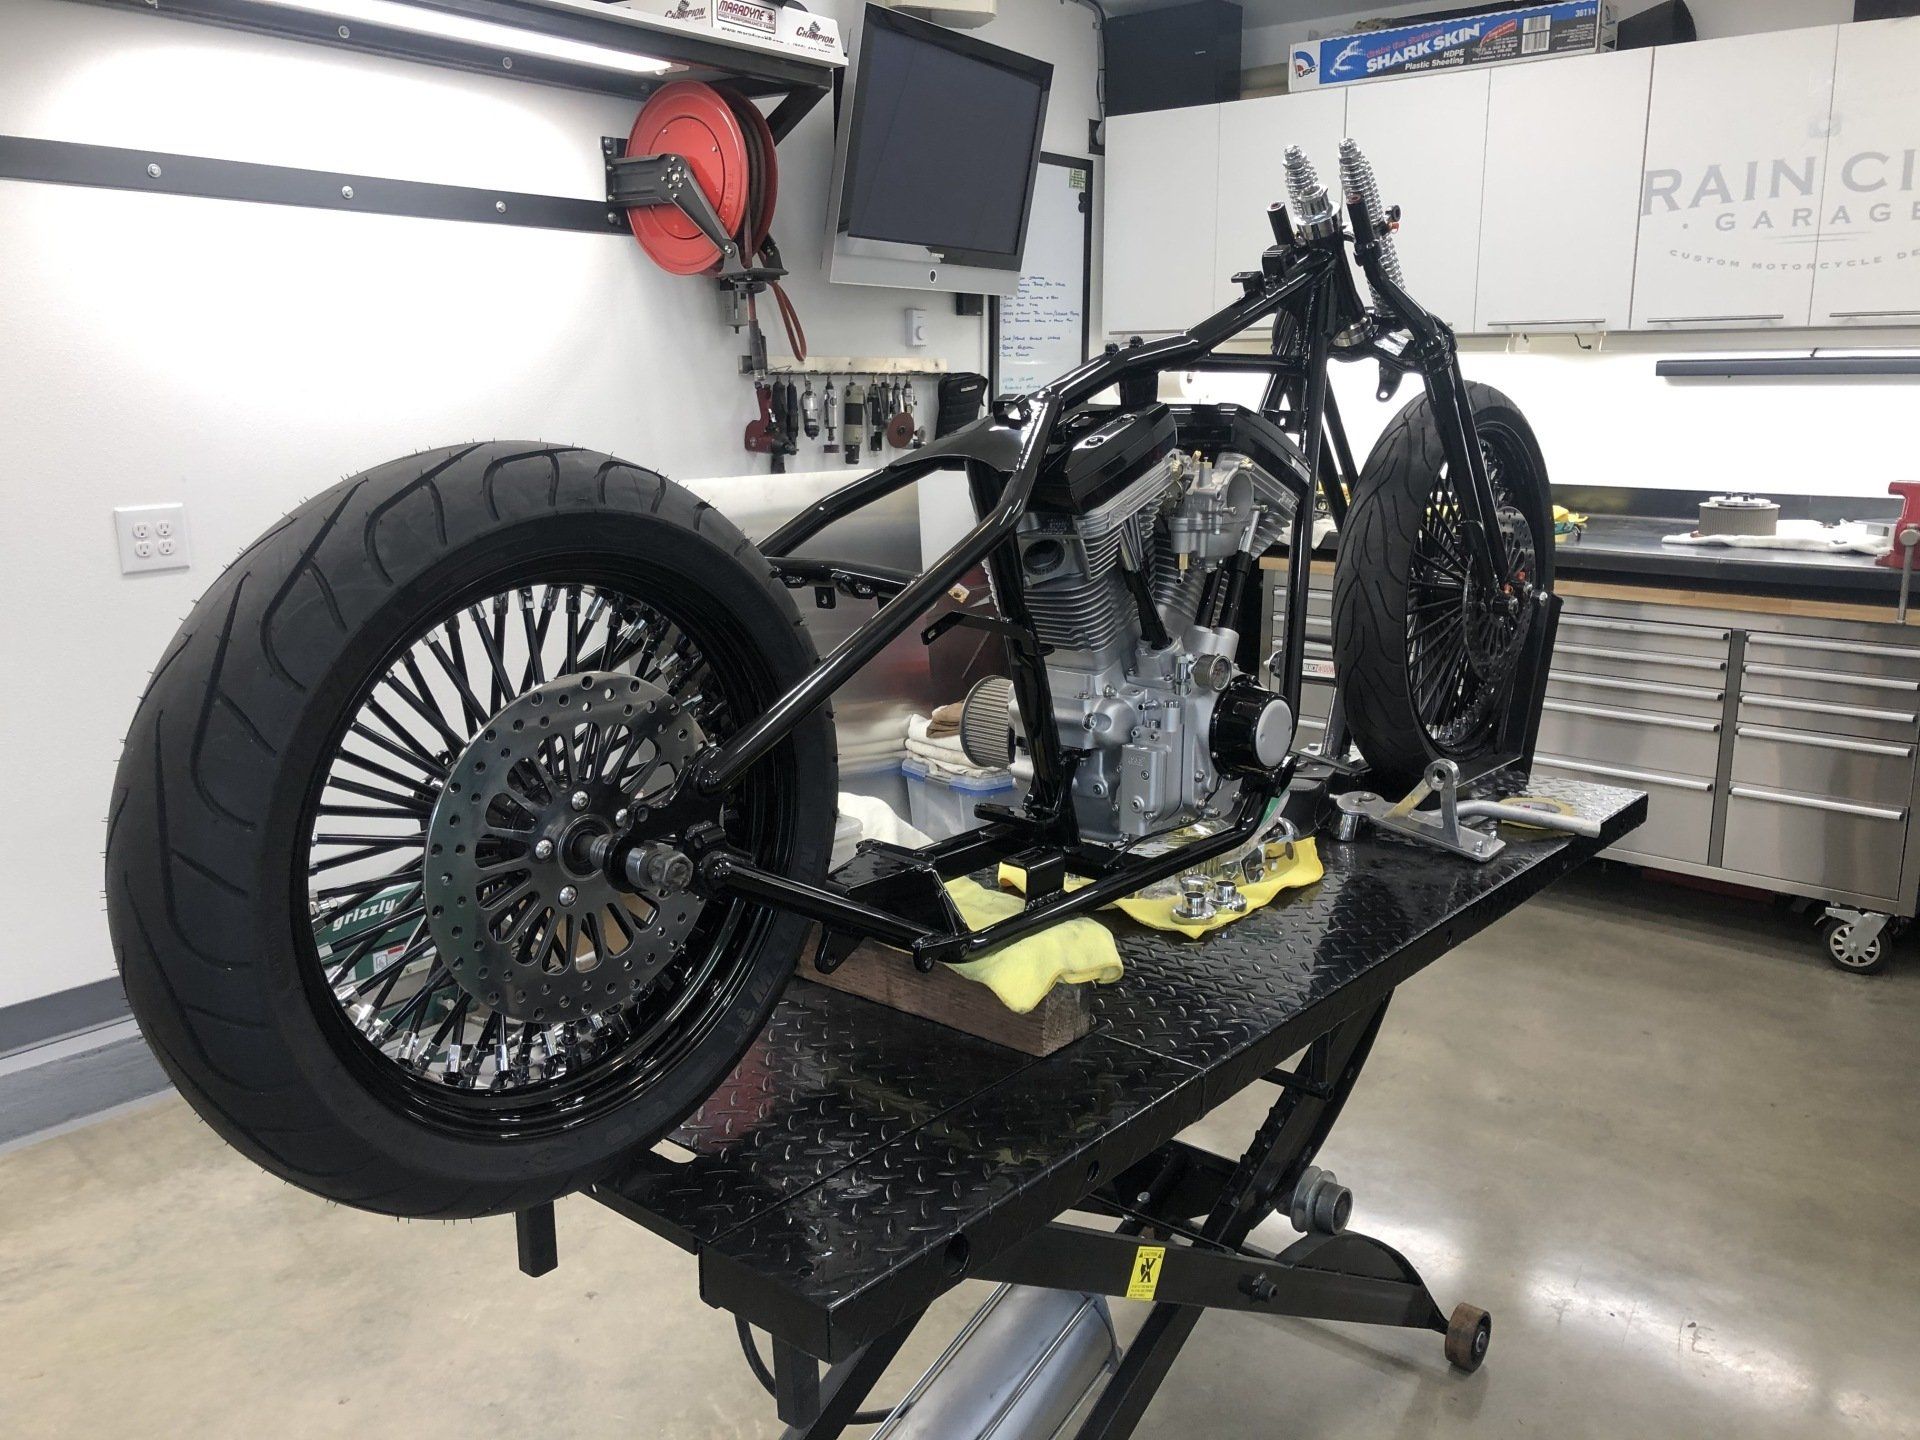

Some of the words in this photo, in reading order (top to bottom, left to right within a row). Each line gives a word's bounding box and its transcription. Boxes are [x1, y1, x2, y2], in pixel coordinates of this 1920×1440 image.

[664, 7, 706, 20] CHAMPION
[719, 0, 765, 20] MARADYNE
[796, 26, 836, 44] CHAMPION
[1366, 40, 1432, 73] SHARK
[1443, 48, 1465, 58] HDPE
[1297, 66, 1317, 78] USC
[1404, 61, 1430, 71] Plastic
[1431, 56, 1465, 68] Sheeting
[1640, 156, 1816, 216] RAIN
[1841, 149, 1916, 193] CI
[1715, 201, 1920, 231] GARAGE
[1669, 249, 1740, 268] CUSTOM
[1751, 256, 1883, 271] MOTORCYCLE
[332, 898, 400, 932] grizzly
